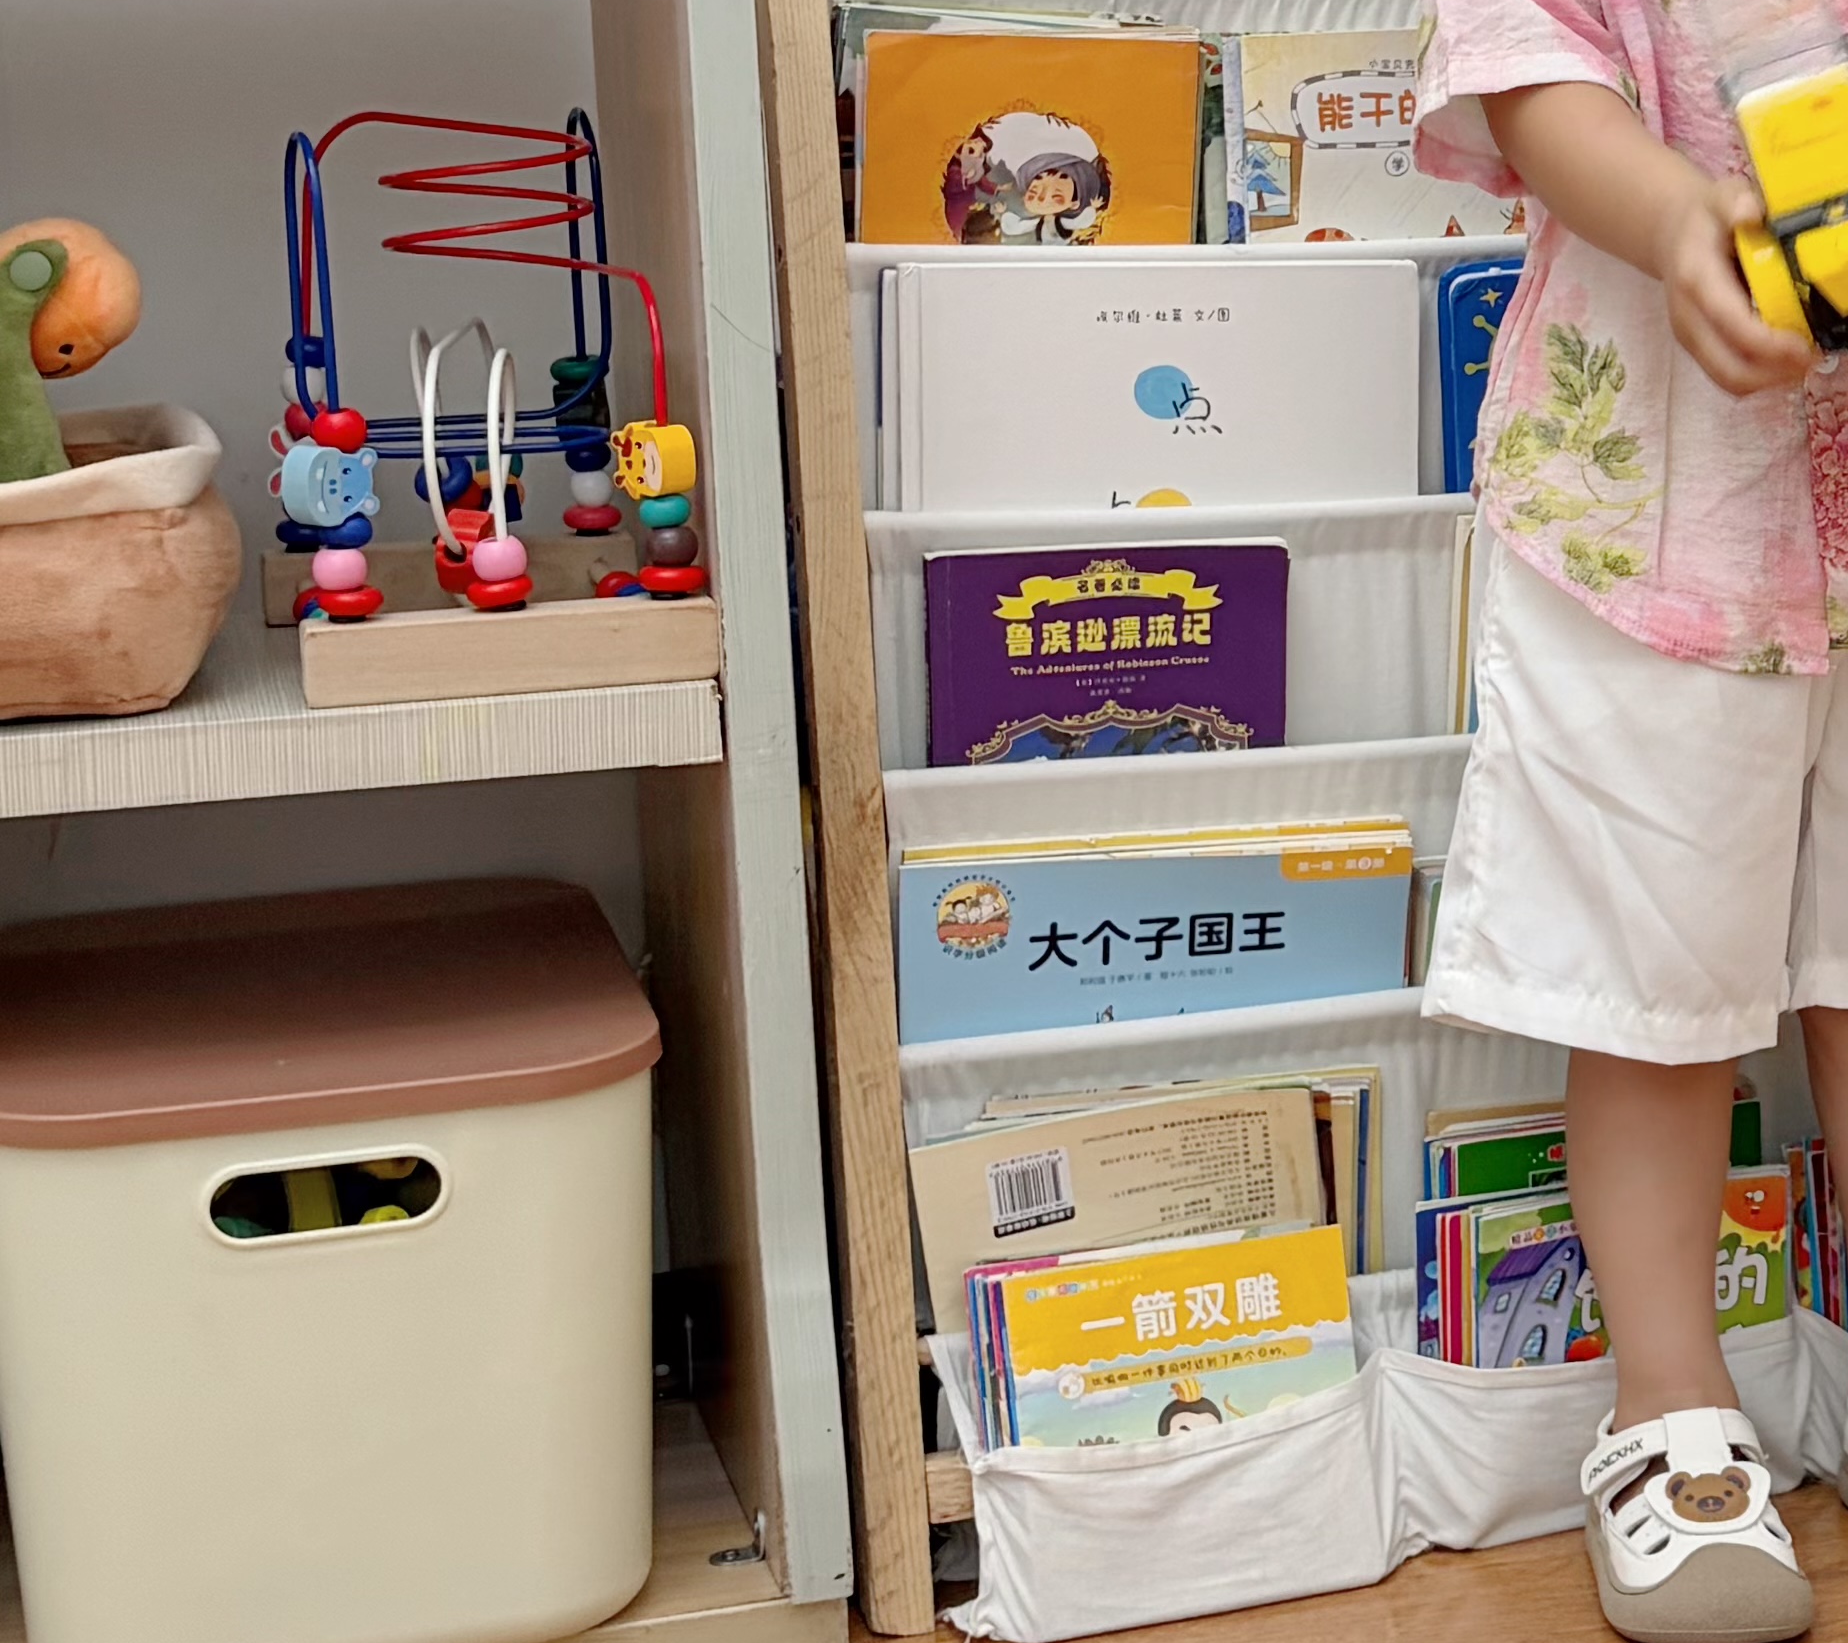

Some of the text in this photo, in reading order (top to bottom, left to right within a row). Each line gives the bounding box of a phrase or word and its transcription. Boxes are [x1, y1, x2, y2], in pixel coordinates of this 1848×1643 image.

[1005, 612, 1212, 657] 鲁滨逊漂流记
[1010, 666, 1033, 676] The
[1103, 661, 1115, 672] of
[1028, 912, 1286, 971] 大个子国王
[1080, 1272, 1282, 1342] 一箭双雕
